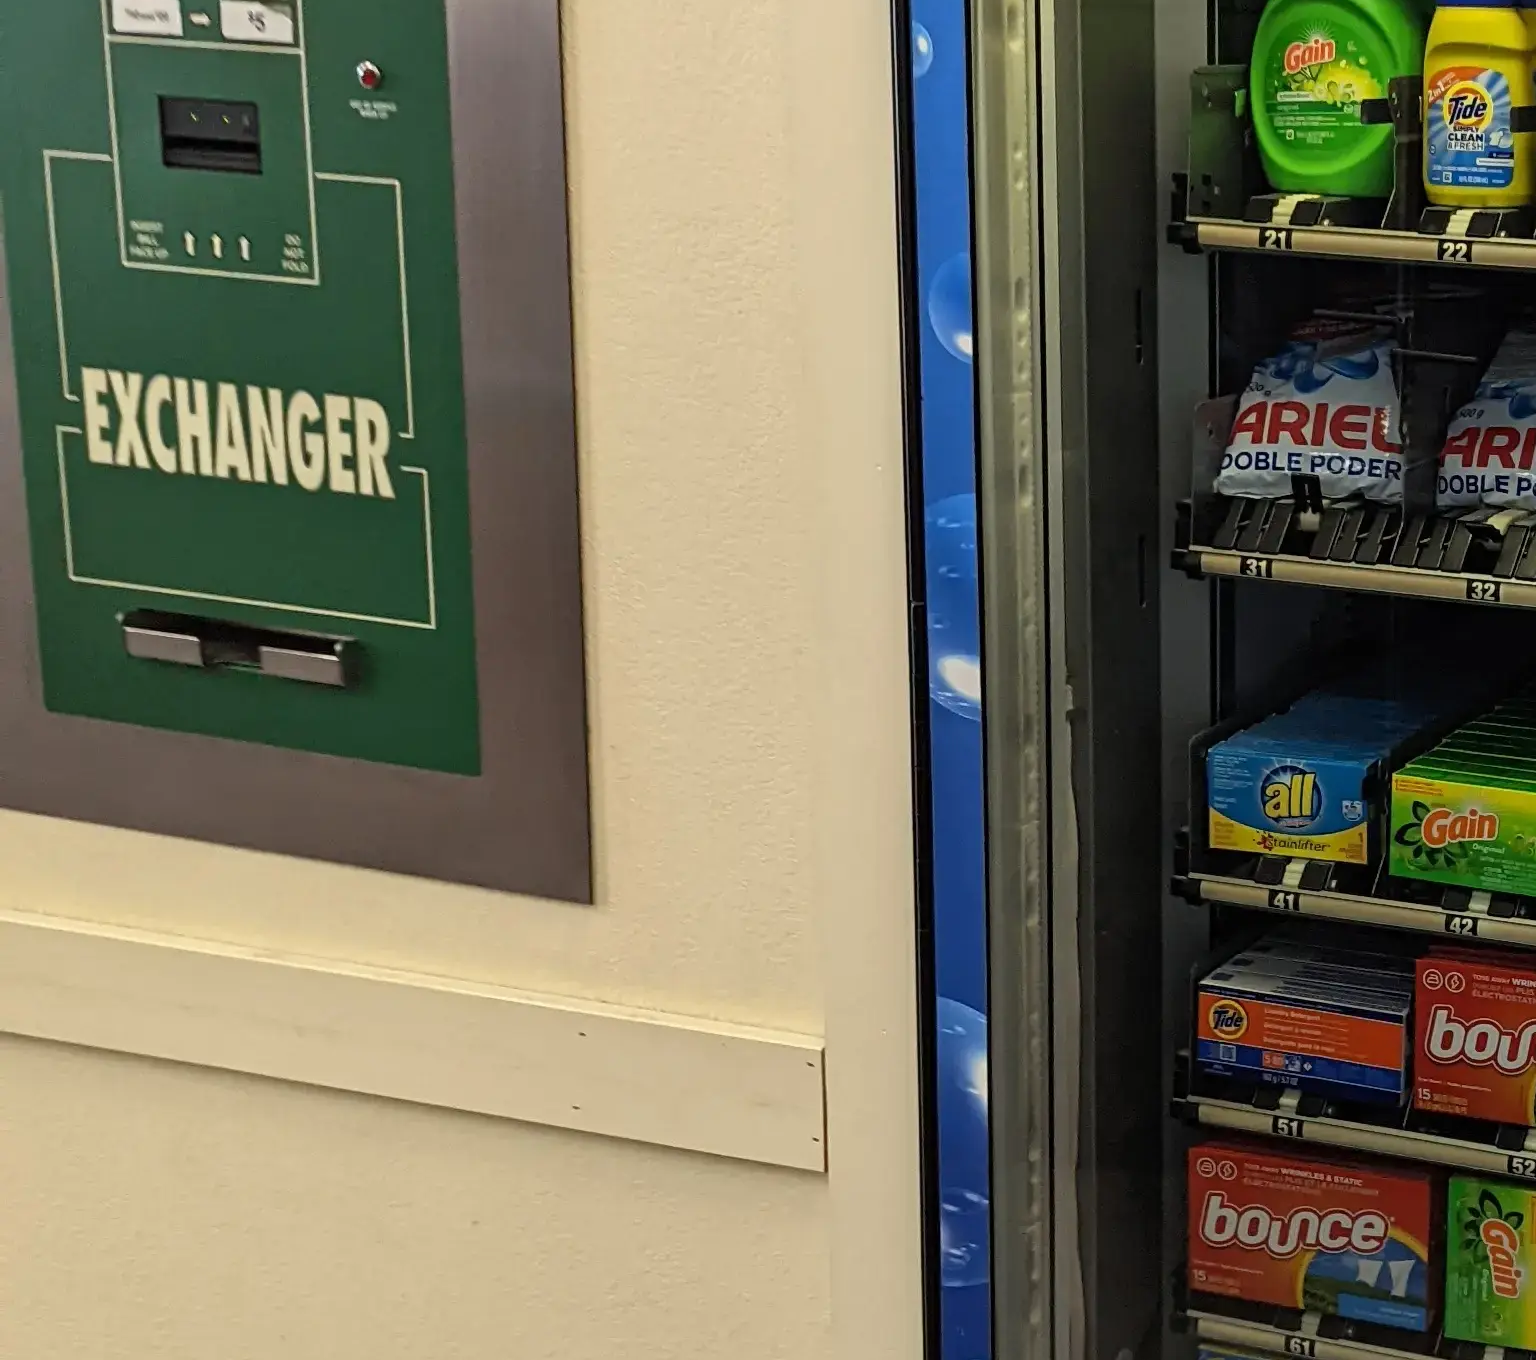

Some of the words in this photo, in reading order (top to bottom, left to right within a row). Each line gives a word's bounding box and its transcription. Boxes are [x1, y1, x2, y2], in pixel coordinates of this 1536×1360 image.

[1285, 38, 1335, 73] Gain
[1448, 94, 1488, 126] Tide
[1447, 133, 1484, 142] CLEAN
[1453, 142, 1484, 151] FRESH
[1264, 229, 1286, 250] 21
[1442, 241, 1468, 262] 22
[81, 366, 396, 500] EXCHANGER
[1227, 400, 1404, 455] ARIEL
[1220, 451, 1302, 472] DOBLE
[1310, 454, 1402, 481] PODER
[1438, 474, 1510, 495] DOBLE
[1246, 558, 1267, 578] 31
[1470, 581, 1496, 601] 32
[1264, 772, 1316, 819] all
[1422, 808, 1500, 848] Gain
[1472, 842, 1506, 855] Original
[1274, 893, 1295, 911] 41
[1450, 918, 1473, 936] 42
[1213, 1009, 1245, 1030] Tide
[1418, 1087, 1432, 1101] 15
[1277, 1119, 1300, 1137] 51
[1511, 1158, 1536, 1177] 52
[1202, 1193, 1387, 1255] bounce
[1480, 1218, 1522, 1299] Gain
[1192, 1269, 1207, 1282] 15
[1289, 1339, 1311, 1357] 61
